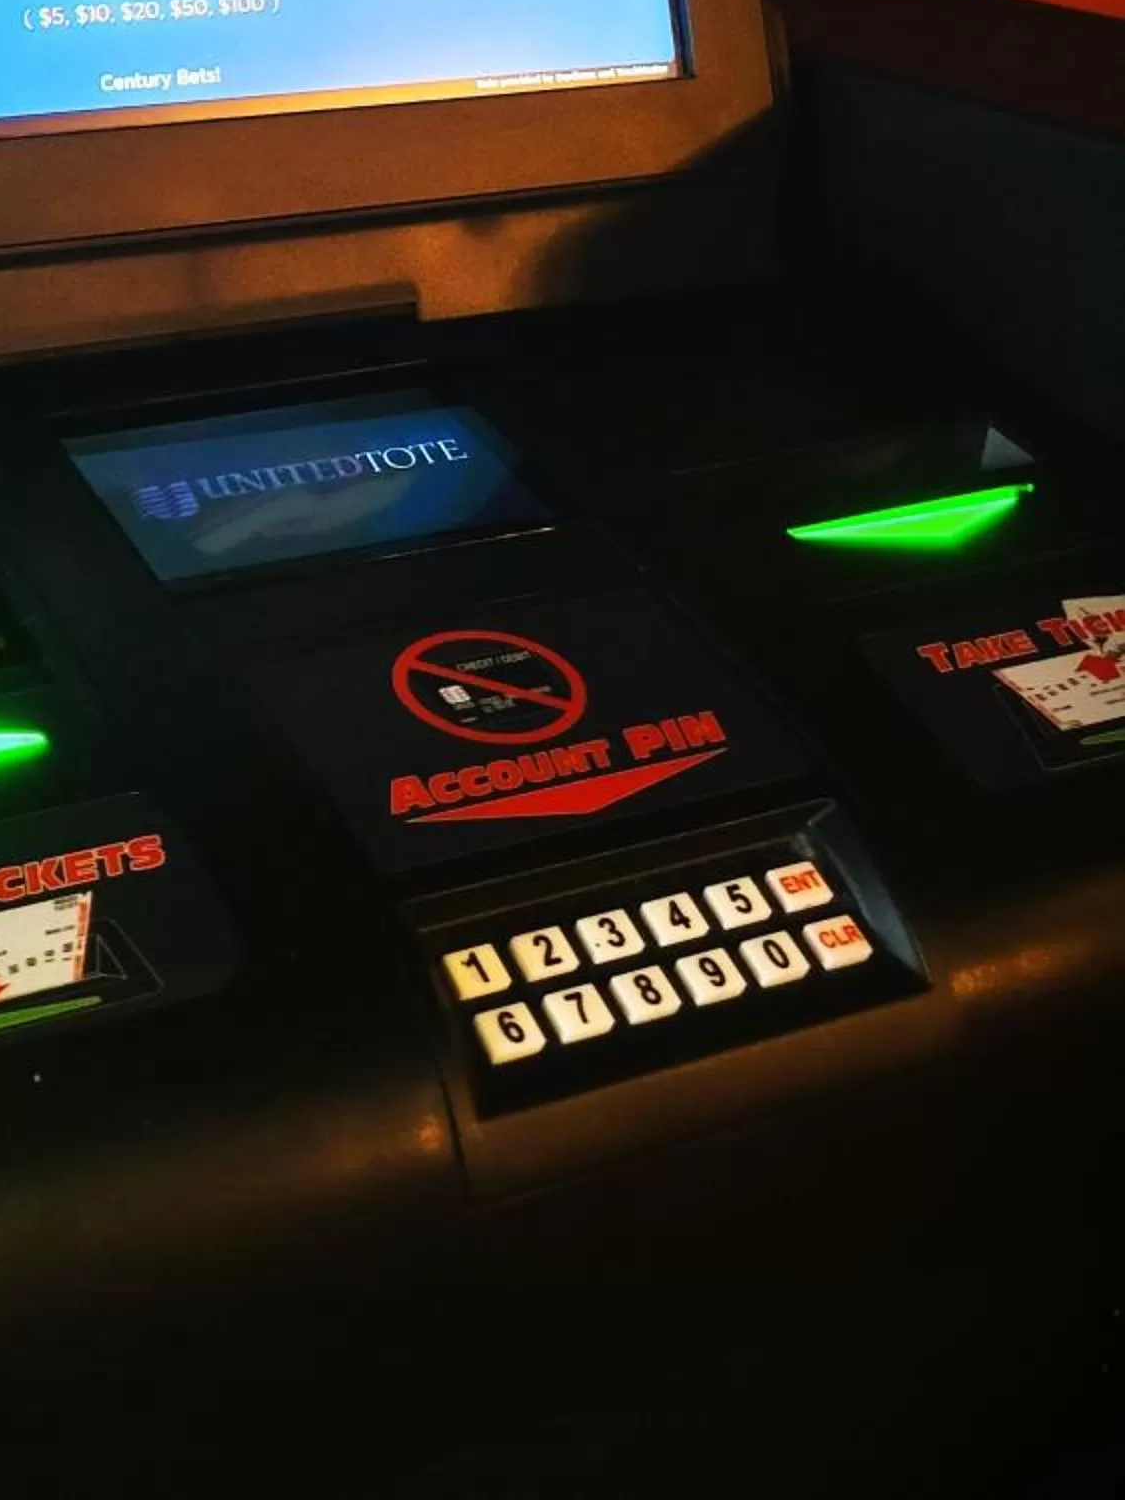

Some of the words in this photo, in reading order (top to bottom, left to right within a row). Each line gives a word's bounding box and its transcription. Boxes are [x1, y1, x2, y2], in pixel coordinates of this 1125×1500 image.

[99, 71, 173, 94] Century
[915, 629, 1039, 673] TAKE
[389, 739, 612, 817] ACCOUNT
[622, 710, 727, 761] PIN
[460, 951, 491, 984] 1
[531, 933, 563, 968] 2
[598, 916, 627, 950] 3
[668, 898, 692, 931] 4
[726, 883, 753, 915] 5
[779, 867, 823, 896] ENT
[496, 1010, 525, 1045] 6
[563, 990, 589, 1026] 7
[633, 973, 663, 1007] 8
[698, 955, 727, 988] 9
[817, 923, 862, 951] CLR
